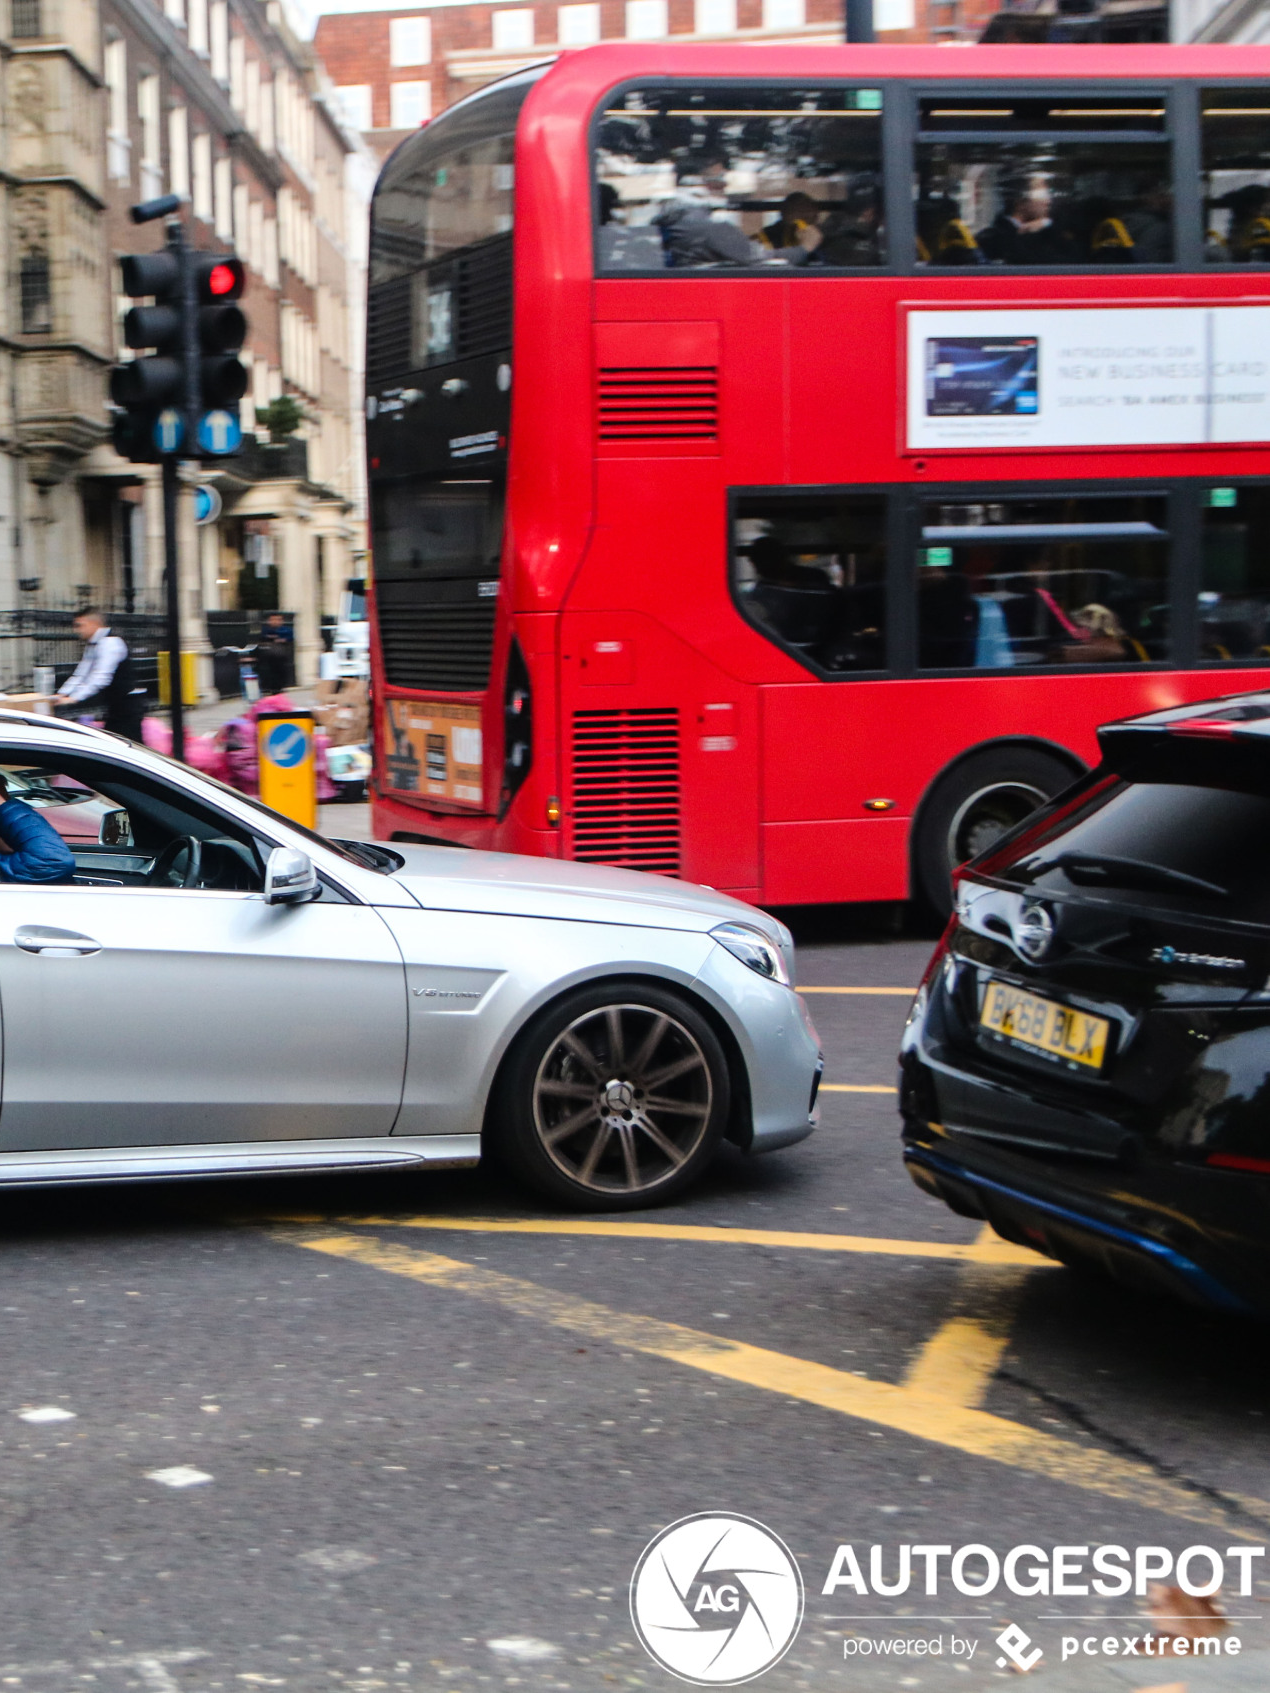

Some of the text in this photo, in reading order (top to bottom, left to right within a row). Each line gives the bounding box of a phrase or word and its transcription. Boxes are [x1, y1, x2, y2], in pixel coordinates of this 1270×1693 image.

[1058, 362, 1266, 379] NEW BUSINESS CARD
[990, 988, 1047, 1040] BK68
[1050, 1009, 1099, 1059] BLX
